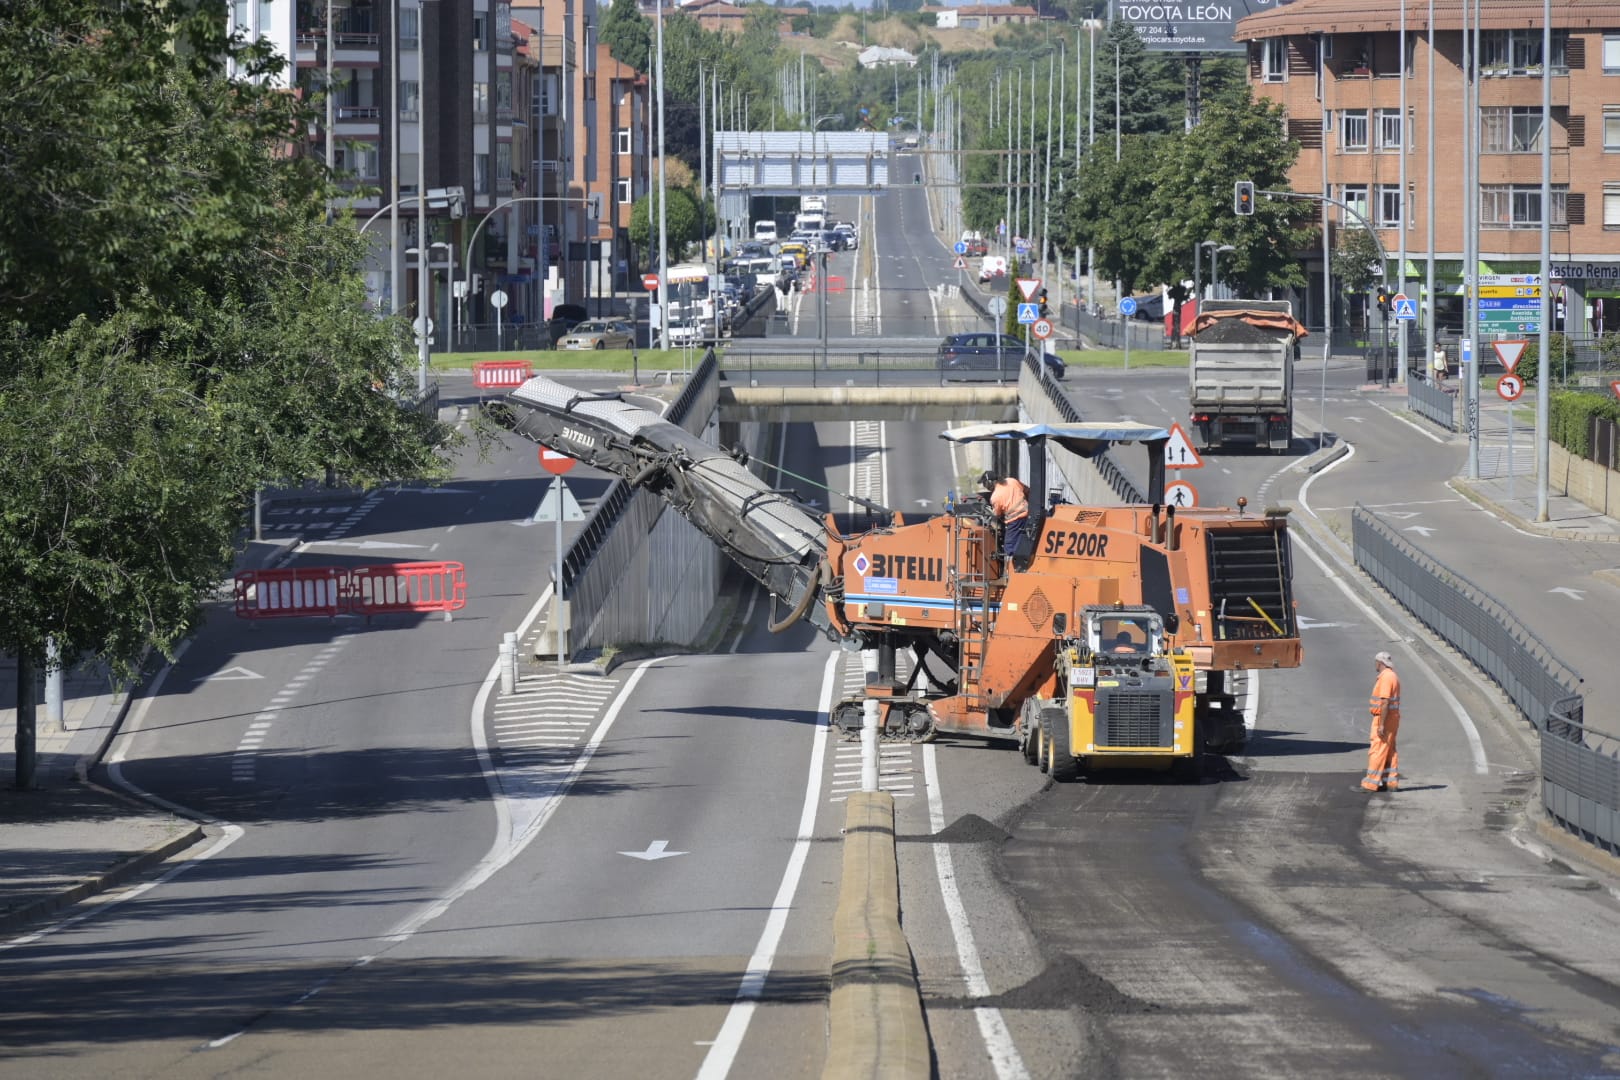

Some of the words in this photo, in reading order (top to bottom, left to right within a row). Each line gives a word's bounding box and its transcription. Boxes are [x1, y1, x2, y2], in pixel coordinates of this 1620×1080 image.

[1120, 6, 1182, 20] TOYOTA
[1187, 2, 1232, 20] LEÓN
[1549, 263, 1583, 277] Rastro
[1036, 324, 1049, 332] 40
[561, 426, 595, 448] BITELLI
[1045, 530, 1066, 554] SF
[1066, 533, 1109, 557] 200R
[872, 553, 943, 582] BITELLI
